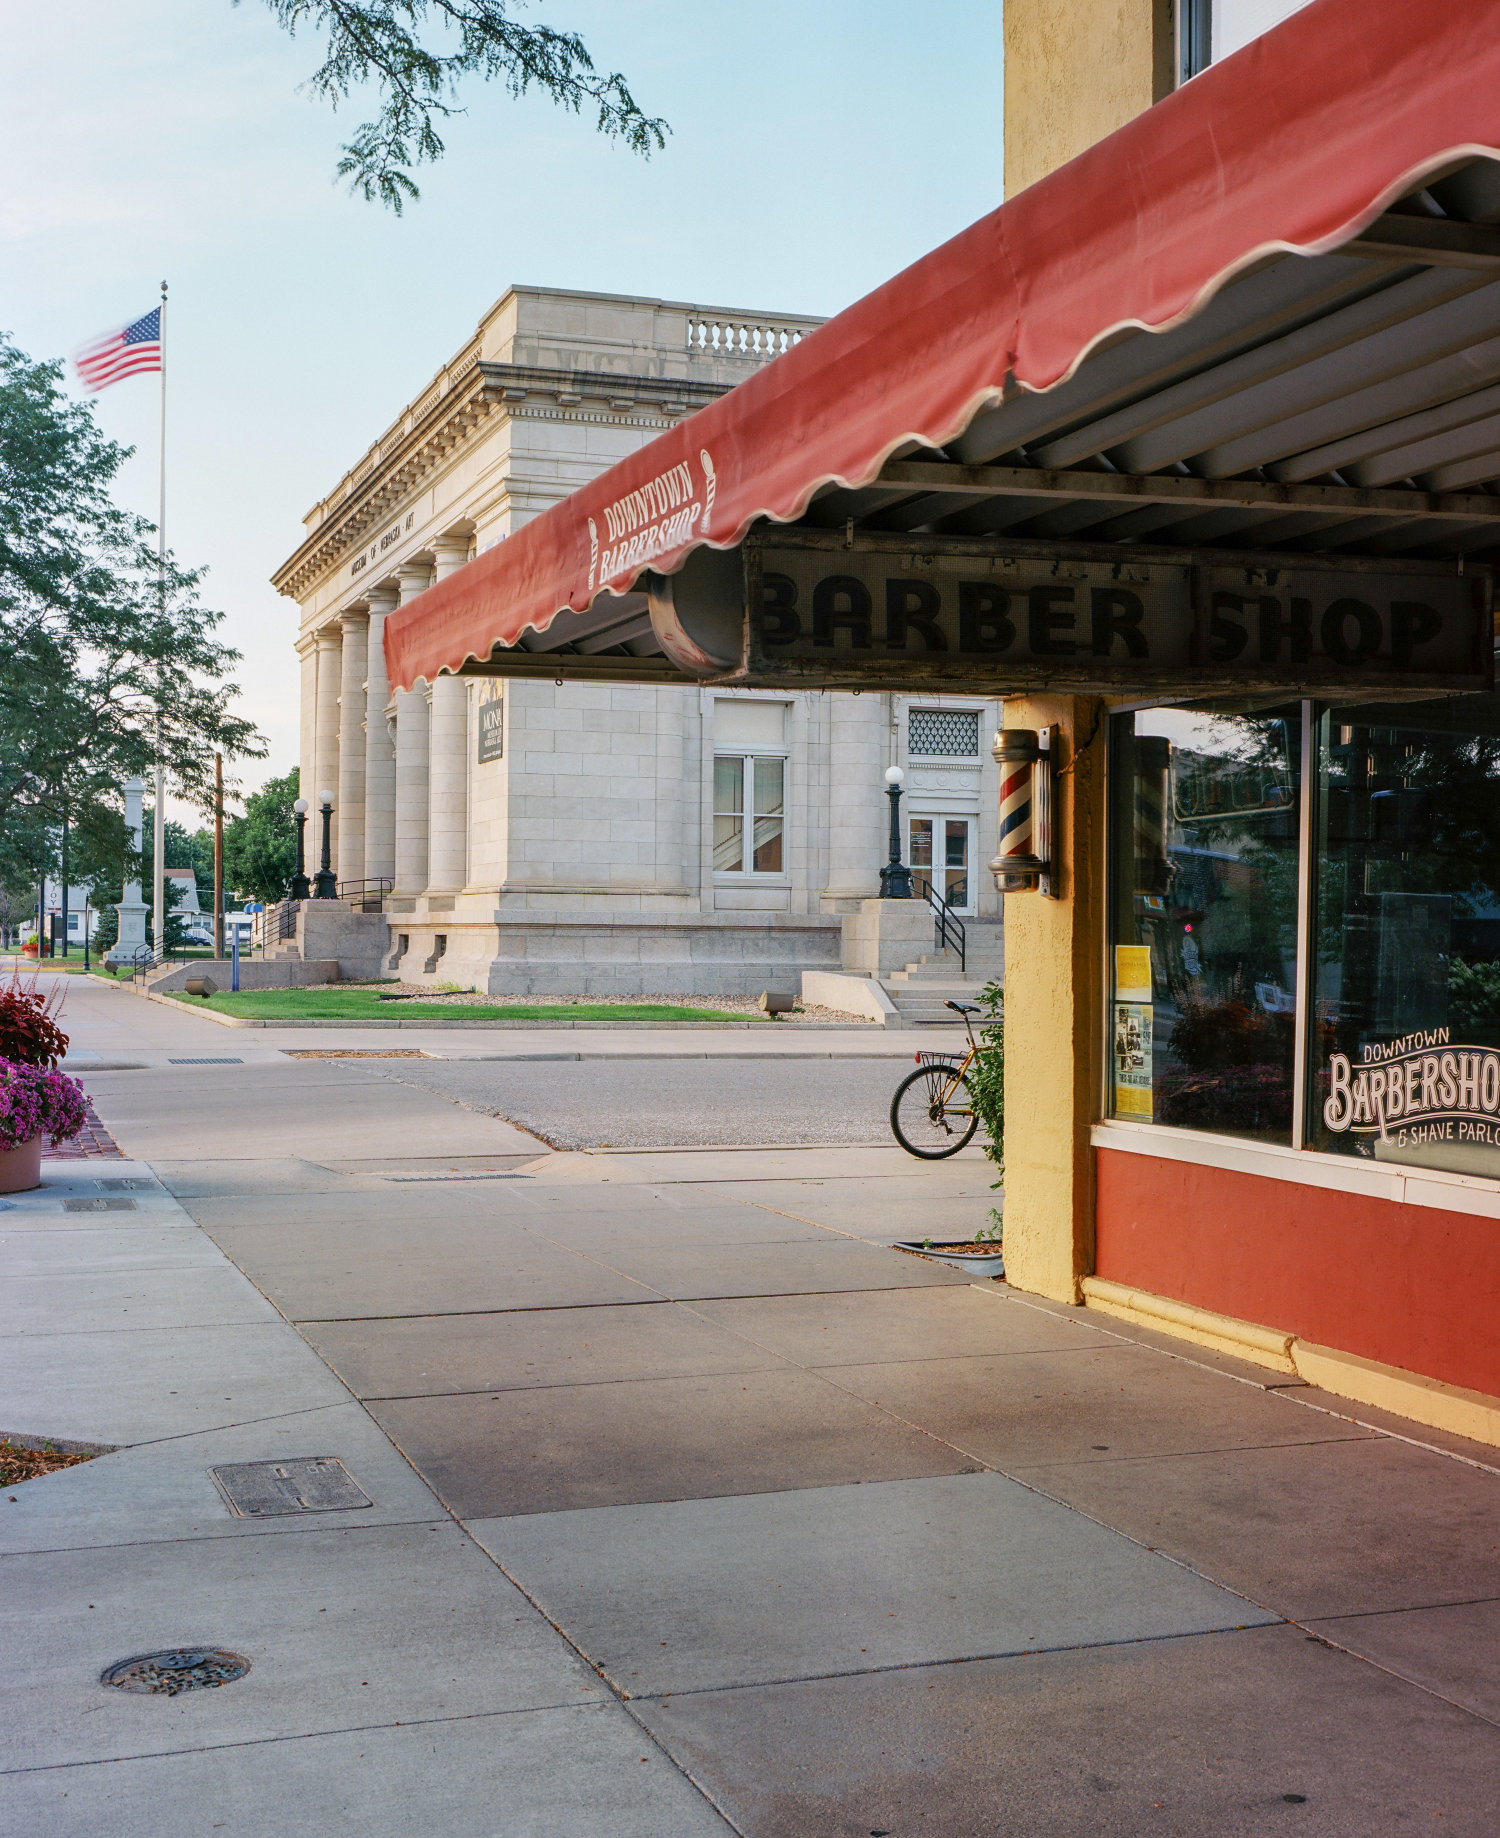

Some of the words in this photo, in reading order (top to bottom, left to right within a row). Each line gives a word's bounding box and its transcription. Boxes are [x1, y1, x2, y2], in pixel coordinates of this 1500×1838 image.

[604, 460, 693, 542] DOWNTOWN
[599, 502, 700, 584] BARBERSHOP
[762, 572, 1149, 658] BARBER
[1211, 591, 1443, 665] SHOP
[1364, 1027, 1449, 1063] DOWNTOWN
[1323, 1052, 1500, 1146] BARBERSHO
[1411, 1122, 1454, 1145] SHAVE
